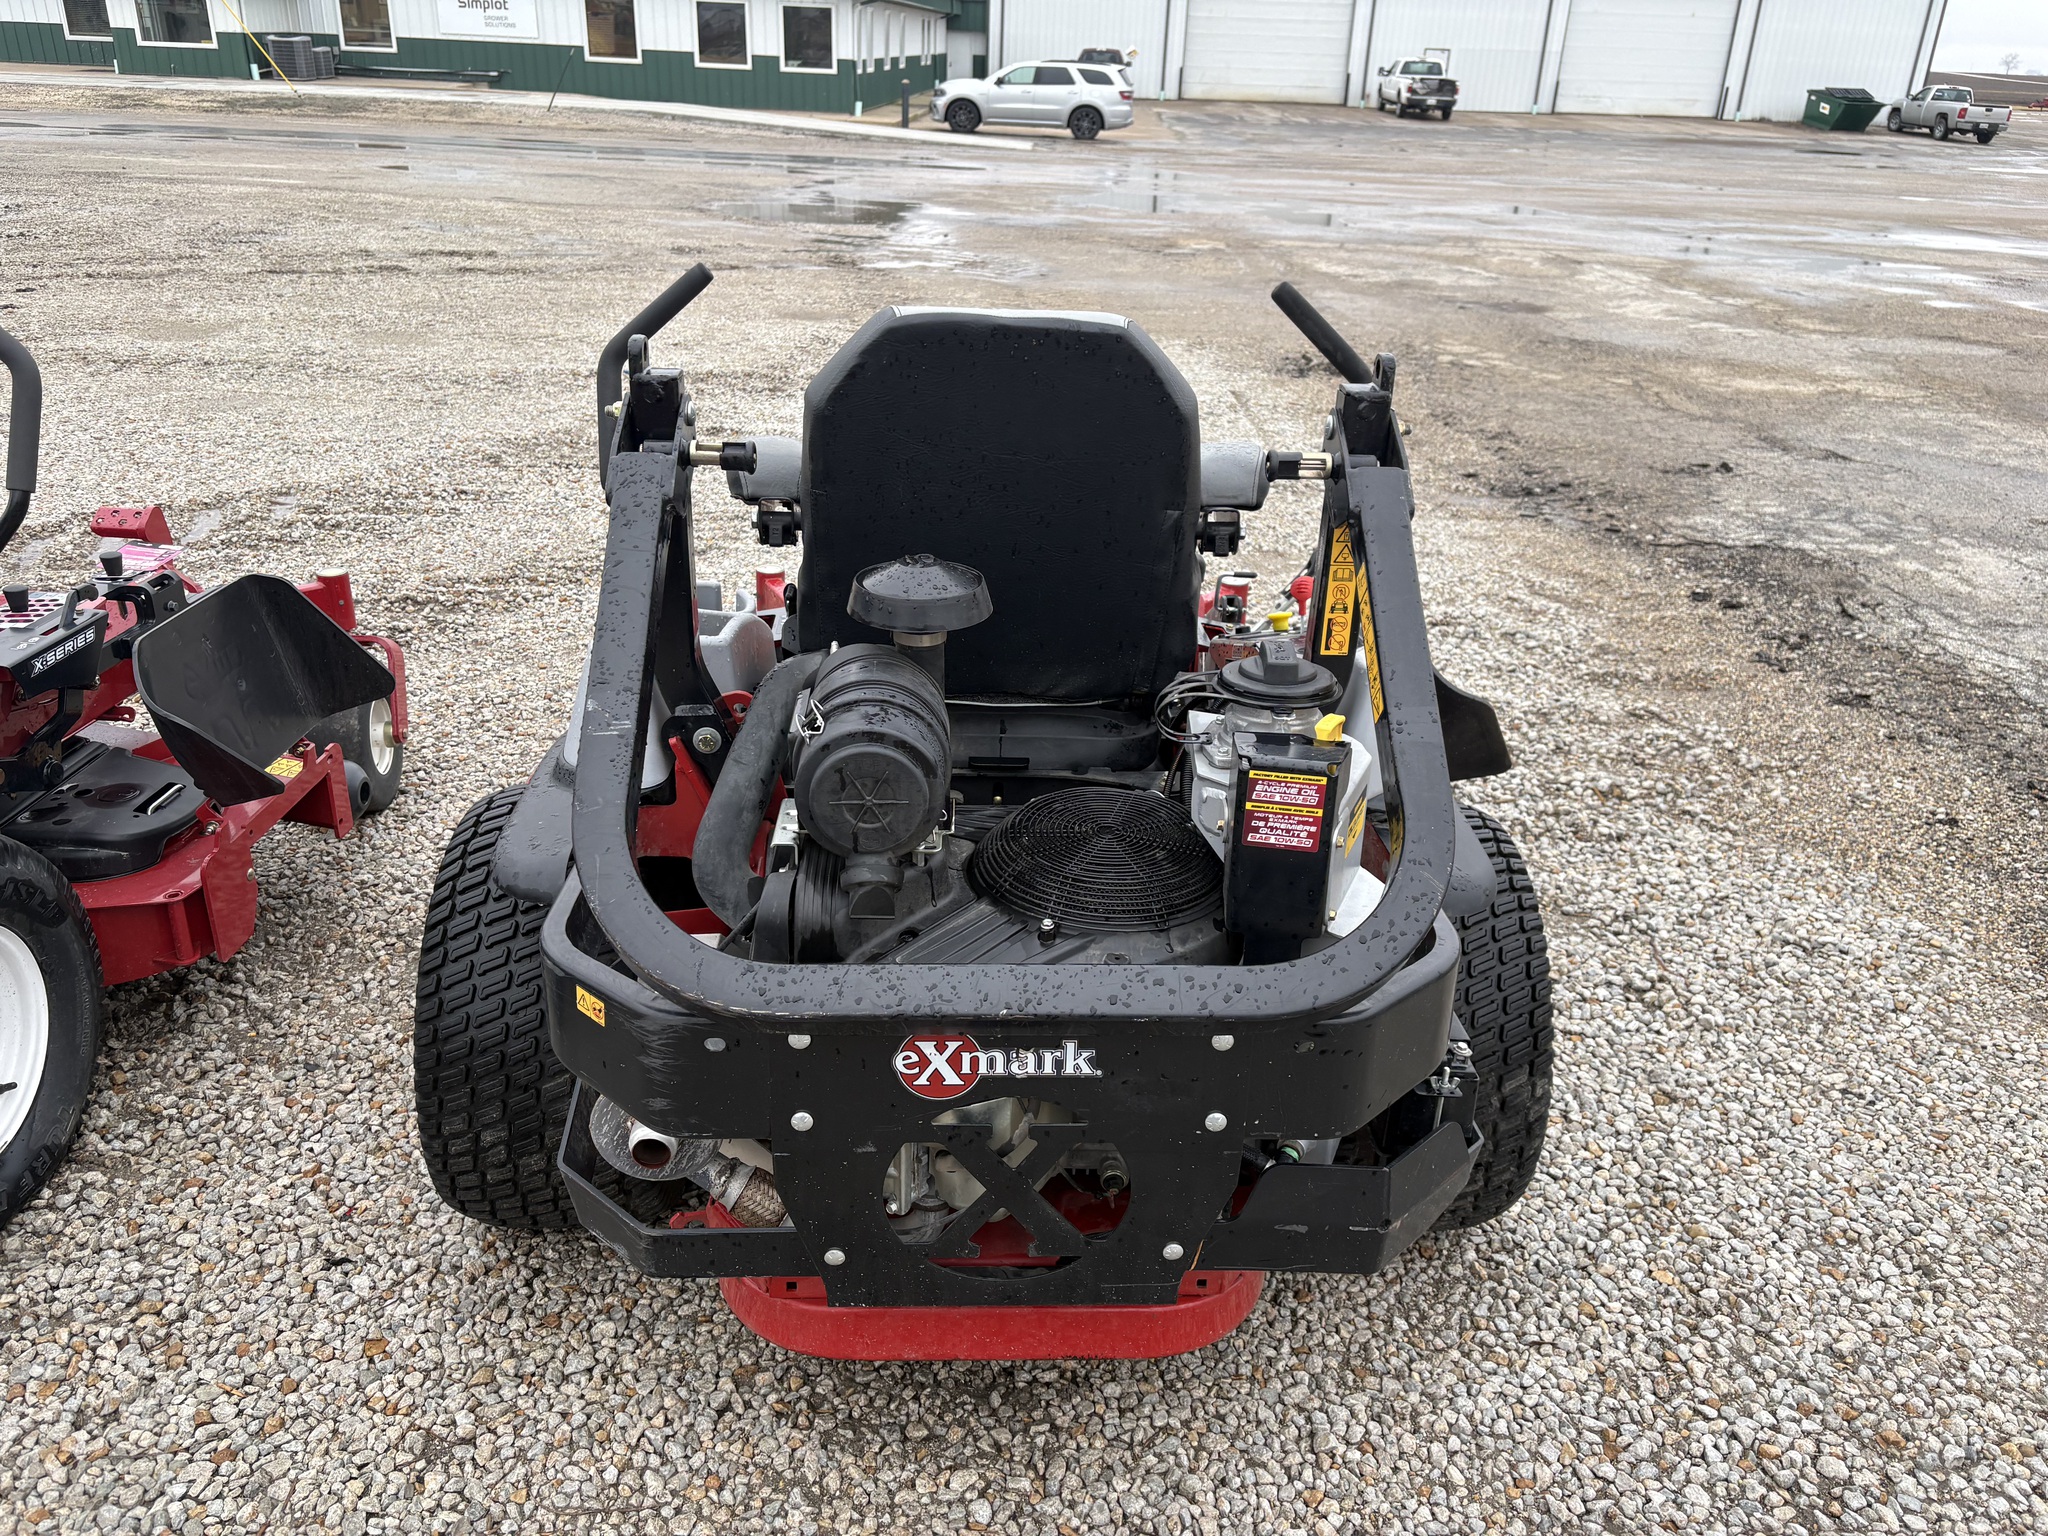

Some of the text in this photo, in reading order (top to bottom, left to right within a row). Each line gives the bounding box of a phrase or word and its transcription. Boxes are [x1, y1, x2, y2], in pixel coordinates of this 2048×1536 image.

[458, 0, 509, 13] Simplot
[1255, 784, 1320, 797] ENGINE OIL
[1259, 827, 1308, 837] QUALITÉ
[1266, 821, 1318, 832] PREMIÈRE
[1250, 834, 1272, 842] SAE
